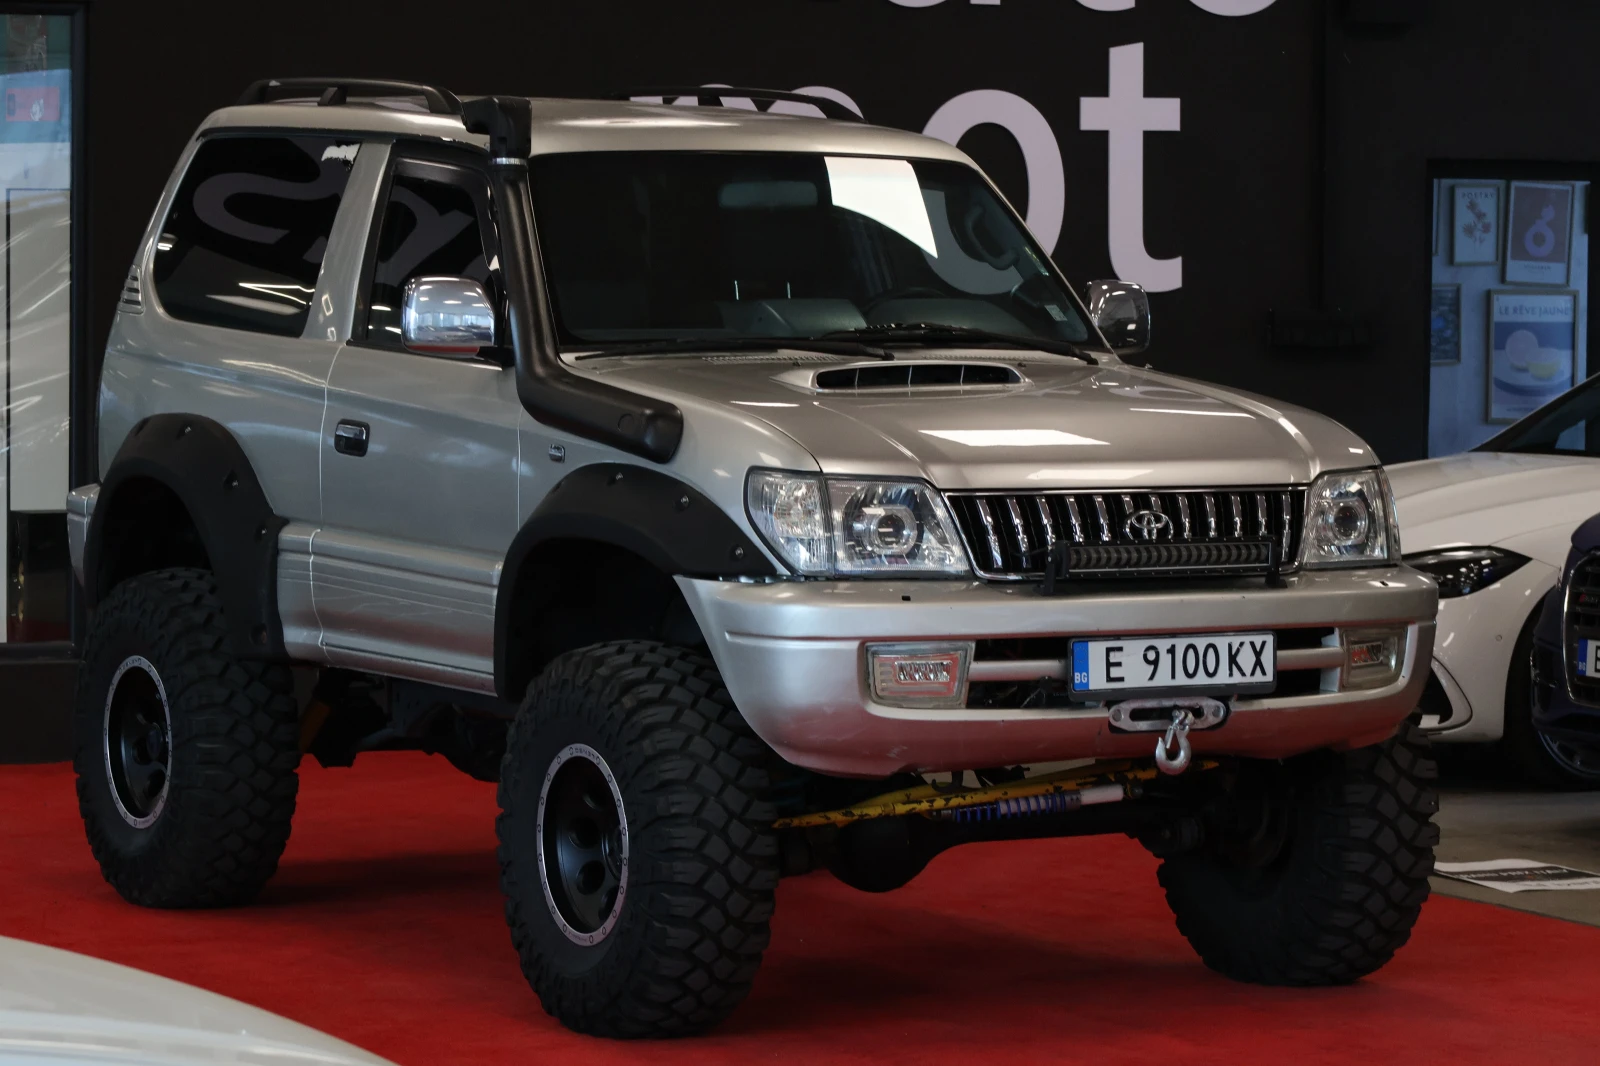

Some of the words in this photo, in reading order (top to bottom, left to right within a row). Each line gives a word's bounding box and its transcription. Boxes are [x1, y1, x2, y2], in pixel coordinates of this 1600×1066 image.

[1499, 307, 1509, 316] LE
[1538, 305, 1570, 318] JAUNE
[1074, 672, 1088, 684] BG
[1105, 646, 1125, 683] E
